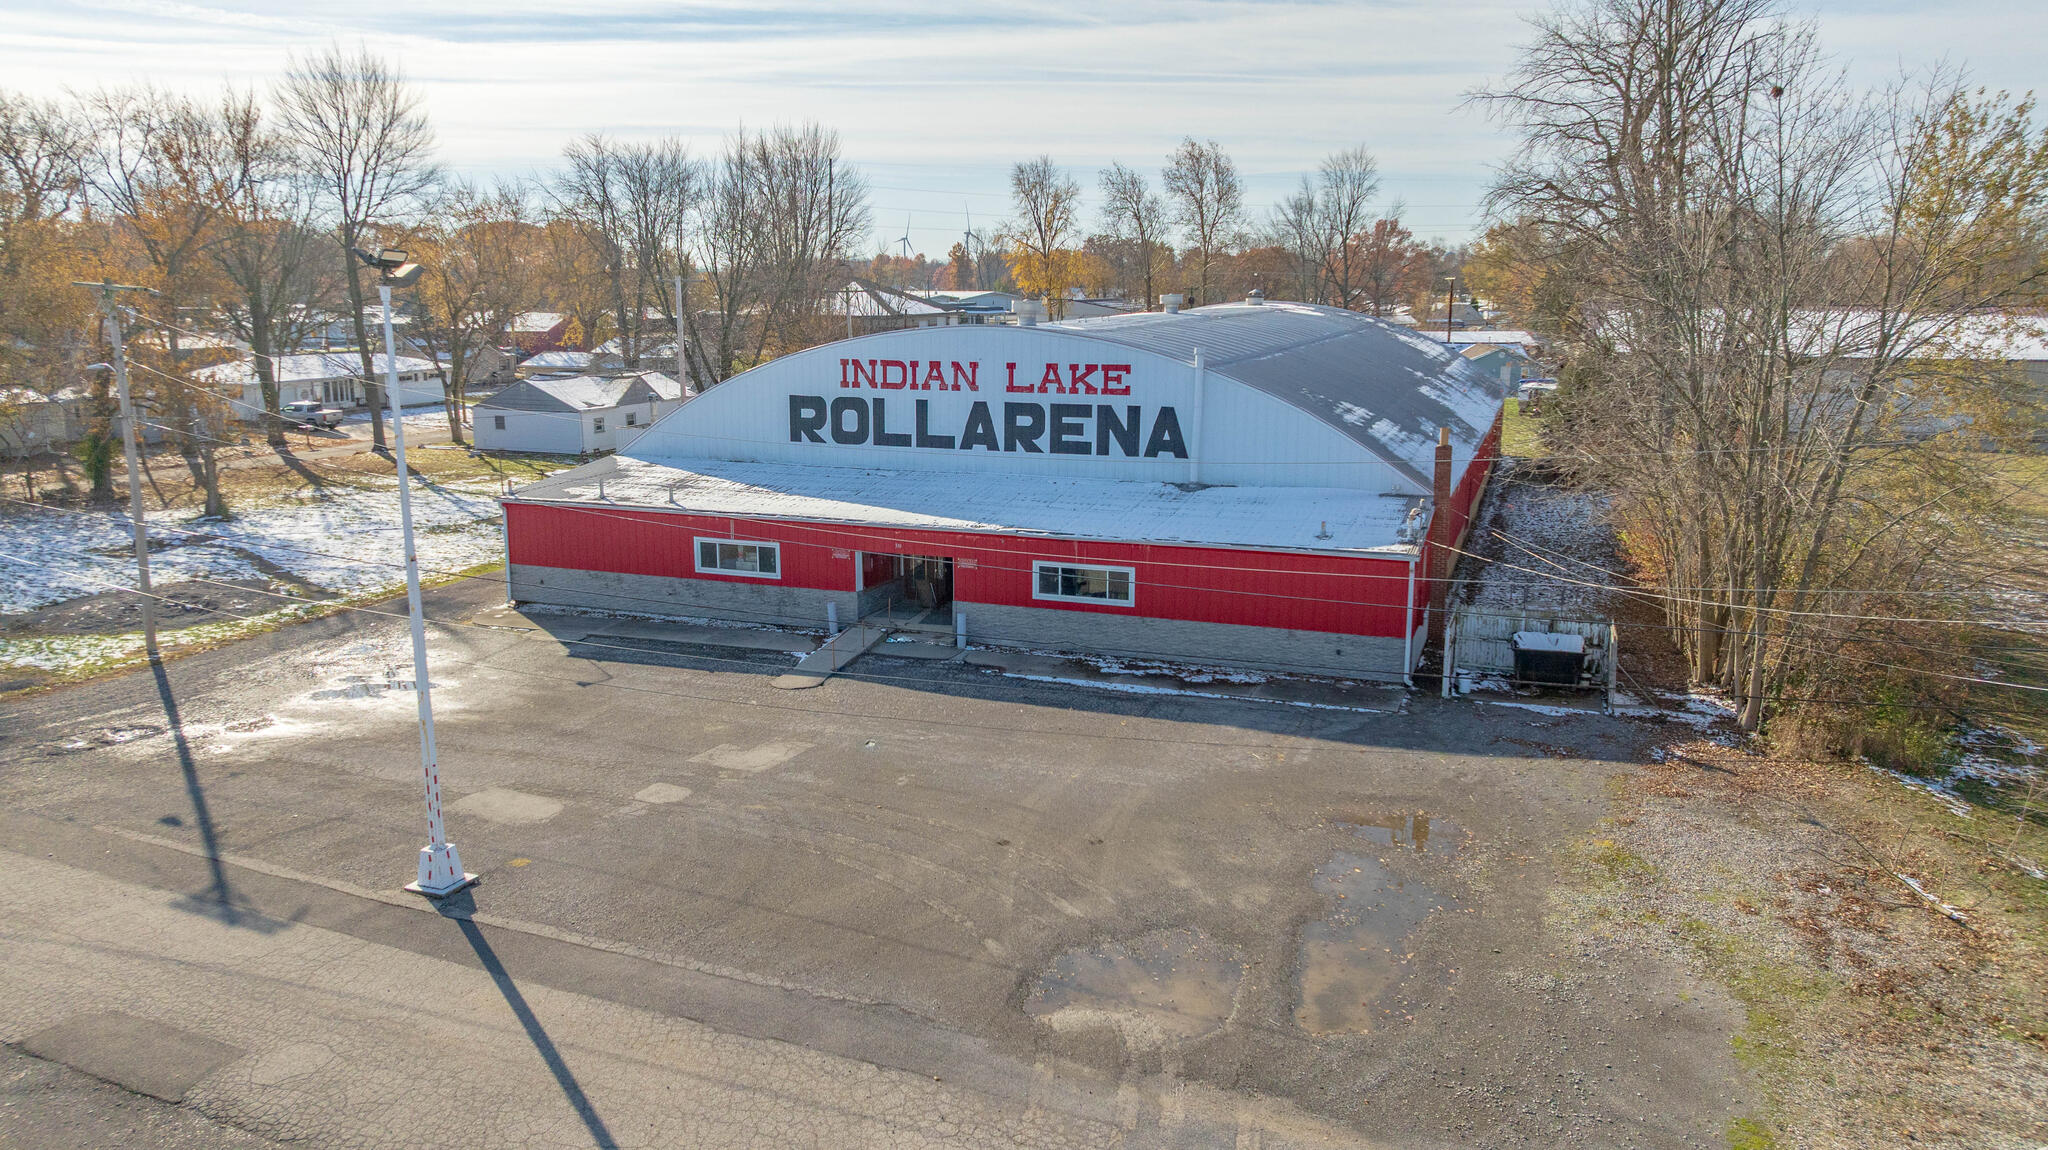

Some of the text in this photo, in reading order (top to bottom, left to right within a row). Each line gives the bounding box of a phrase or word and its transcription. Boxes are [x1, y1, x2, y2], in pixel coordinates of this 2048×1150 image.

[840, 359, 1131, 395] INDIAN LAKE
[789, 395, 1188, 459] ROLLARENA
